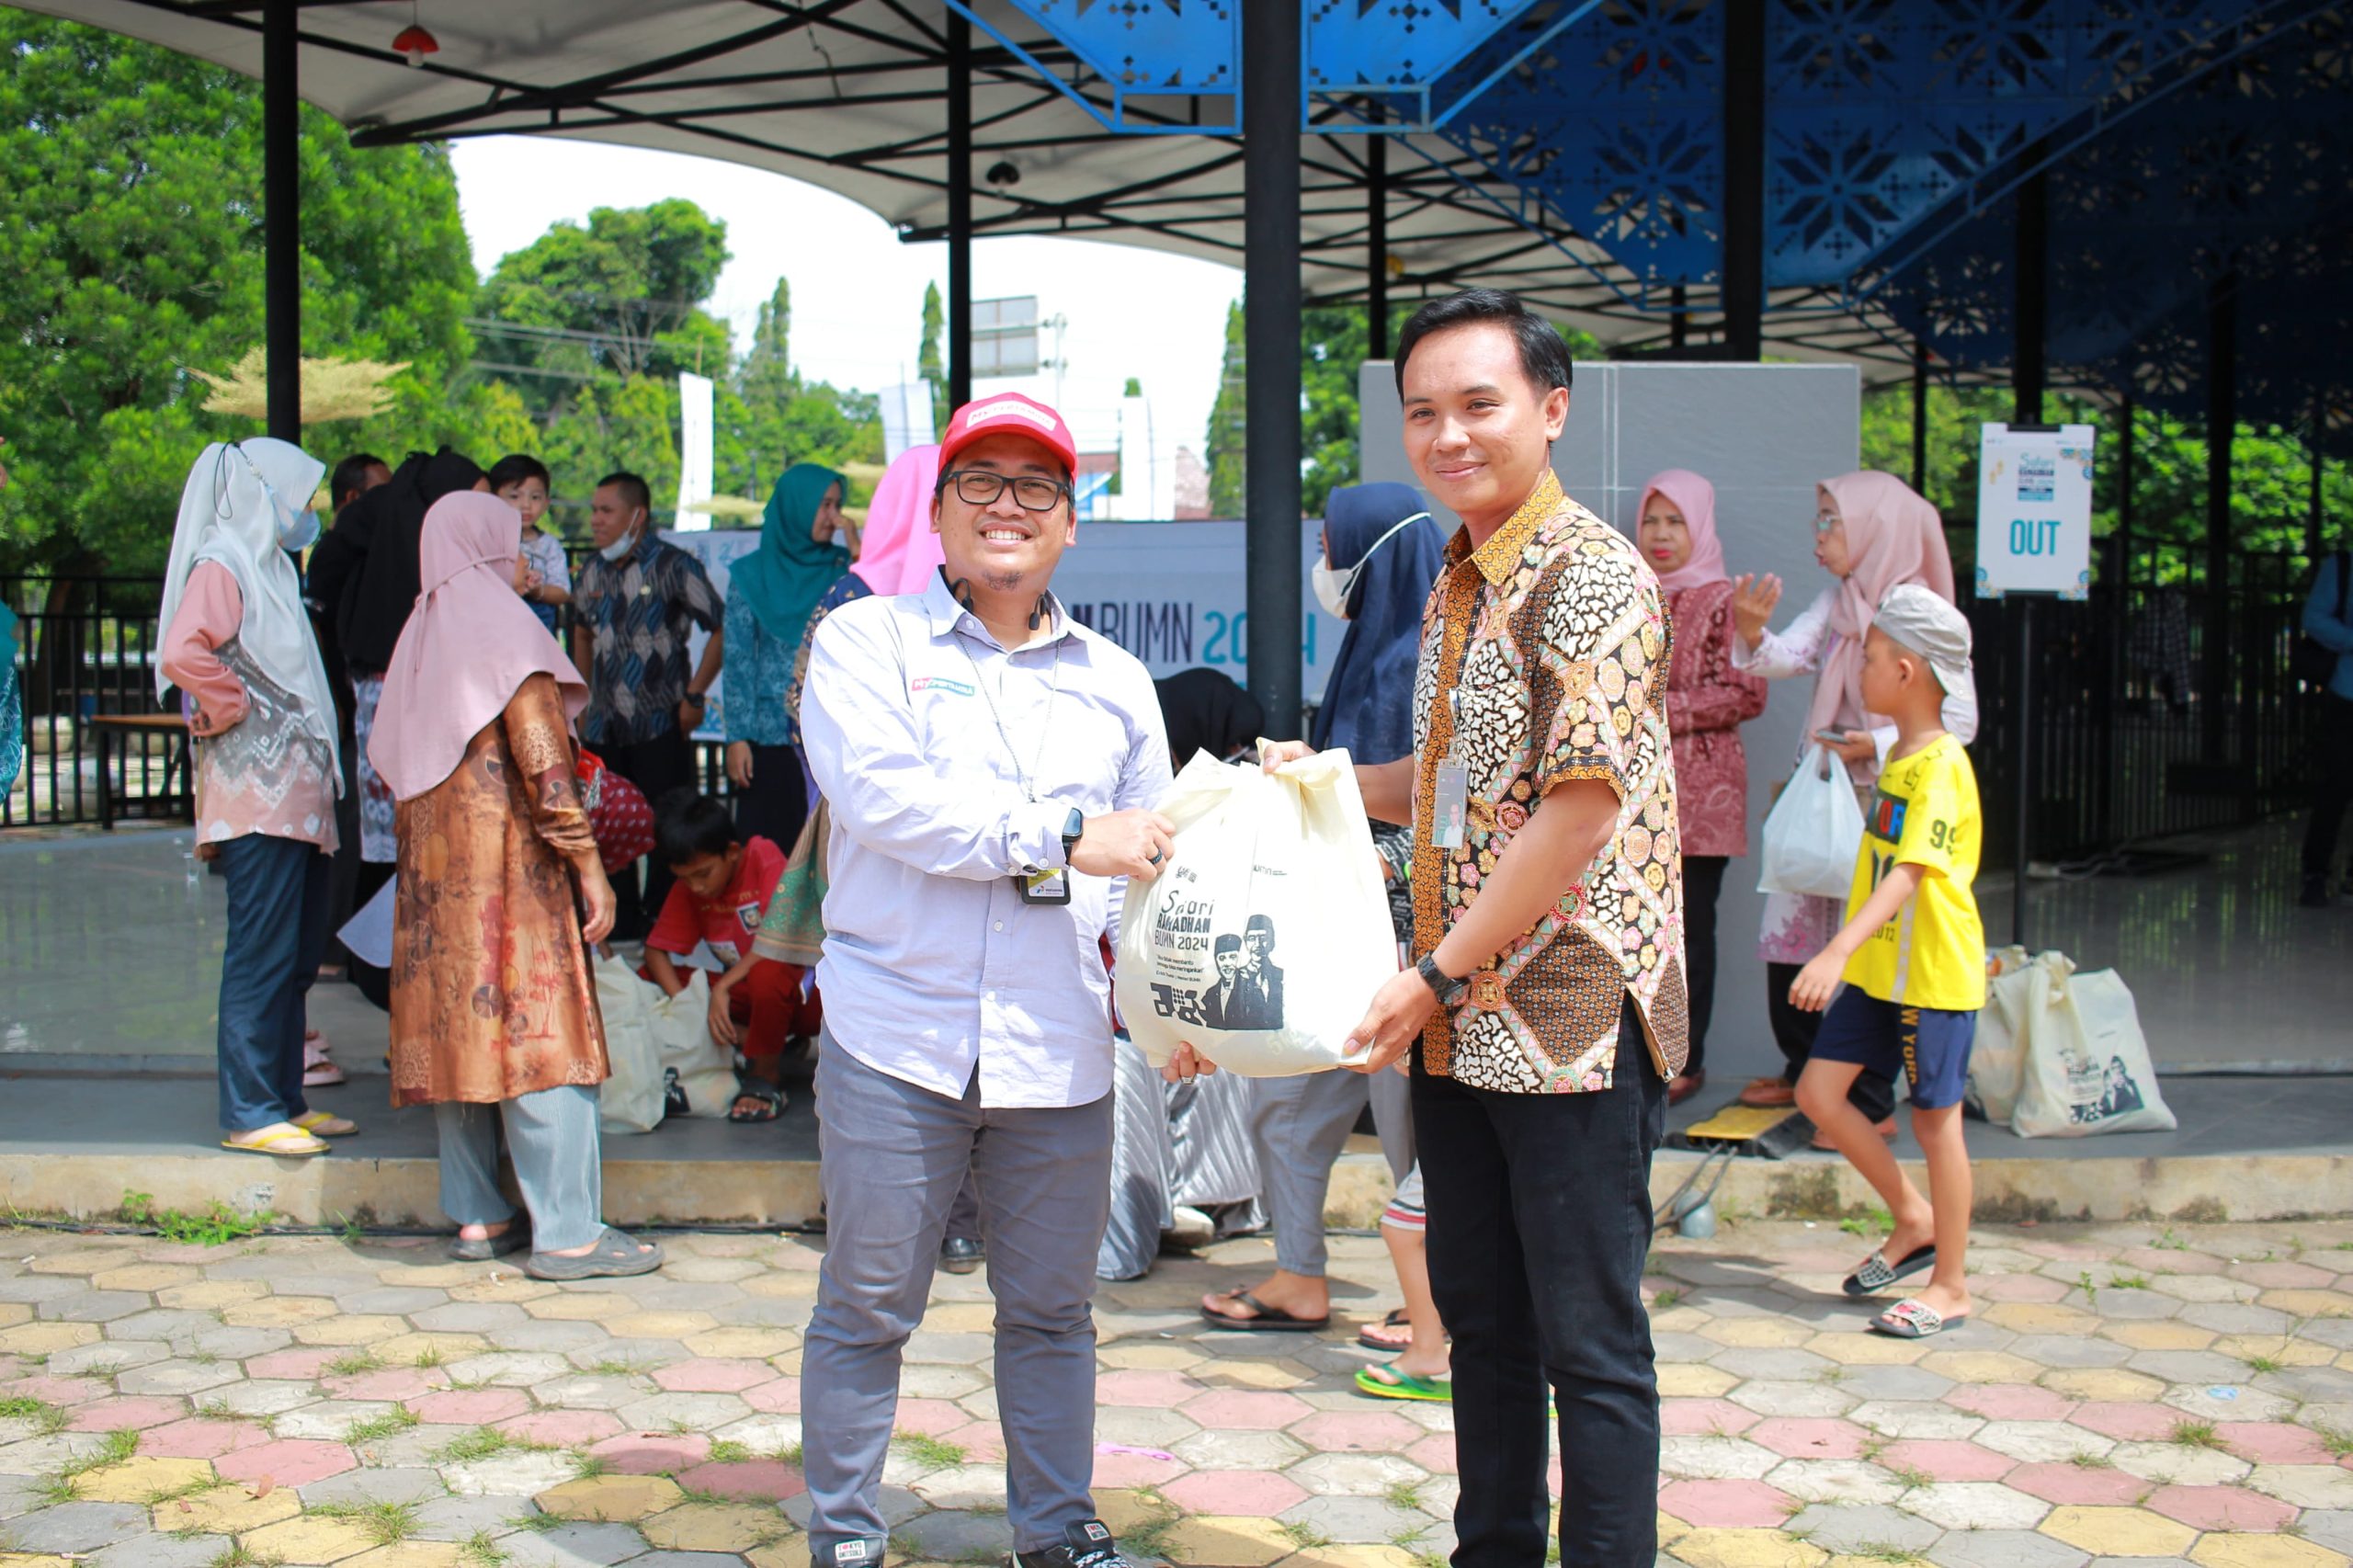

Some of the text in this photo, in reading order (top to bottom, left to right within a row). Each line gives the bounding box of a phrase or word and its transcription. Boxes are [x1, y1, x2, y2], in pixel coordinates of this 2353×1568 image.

[2010, 519, 2061, 556] OUT
[1101, 602, 1193, 664] BUMN
[1202, 610, 1316, 665] 204
[1154, 929, 1209, 951] BUMN 2024
